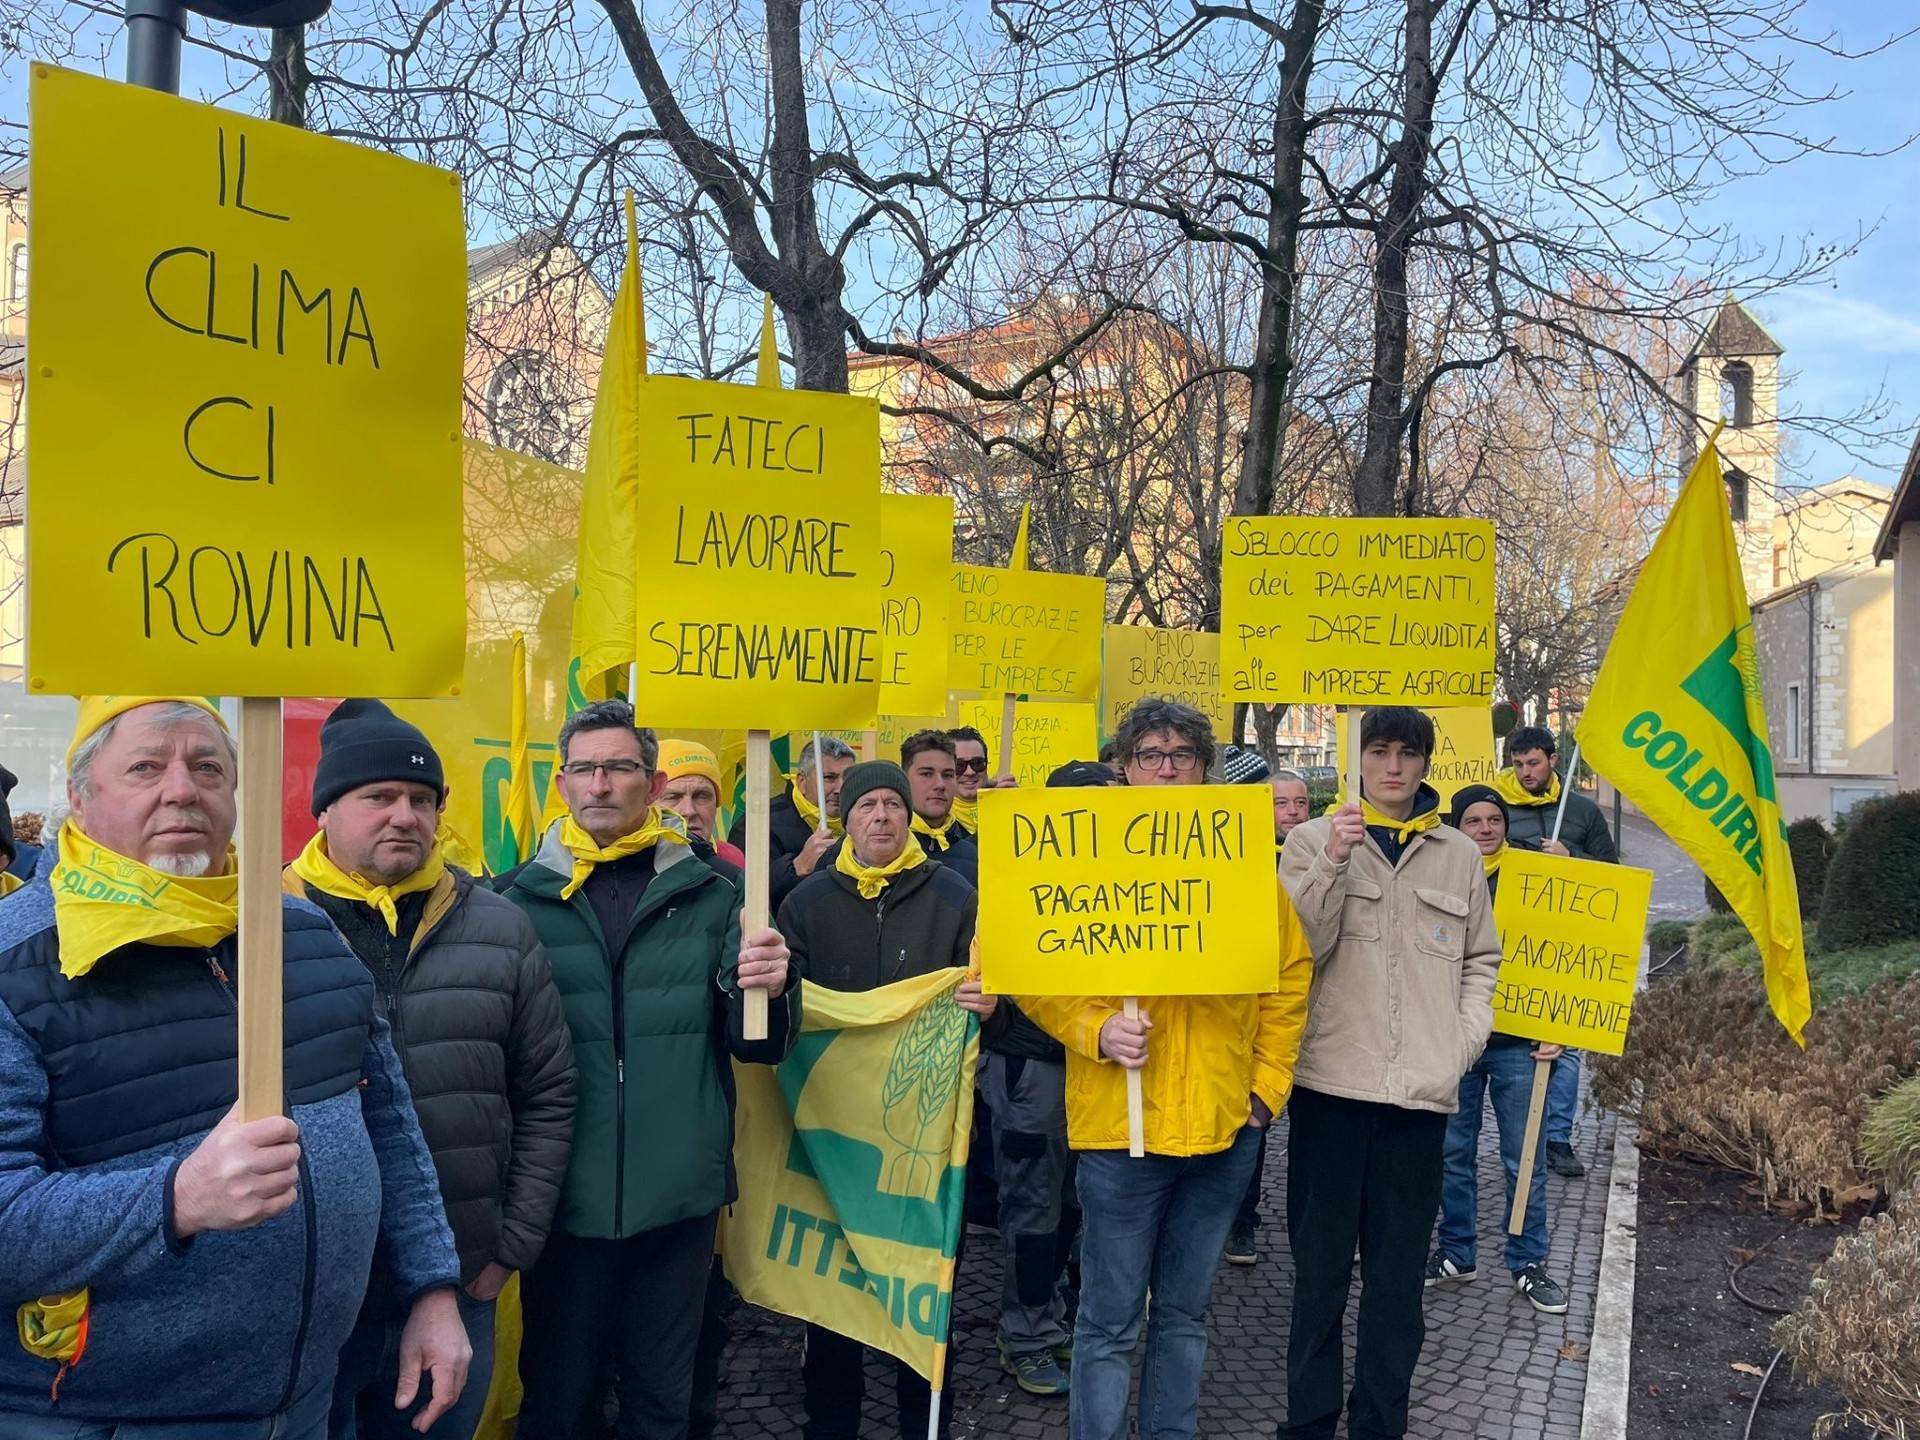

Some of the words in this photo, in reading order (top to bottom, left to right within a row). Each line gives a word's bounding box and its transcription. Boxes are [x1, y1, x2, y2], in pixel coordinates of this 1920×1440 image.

[218, 127, 290, 221] IL
[145, 246, 380, 370] CLIMA
[183, 396, 275, 484] CI
[677, 413, 824, 474] FATECI
[674, 505, 856, 578] LAVORARE
[1230, 520, 1340, 557] SBLOCCO
[1358, 532, 1486, 562] IMMEDIATO
[107, 532, 395, 652] ROVINA
[1248, 569, 1295, 597] dei
[964, 601, 1080, 633] BUROCRAZIE
[1238, 623, 1282, 651] per
[1305, 615, 1382, 646] DARE
[649, 620, 878, 684] SERENAMENTE
[954, 633, 986, 656] PER
[1001, 637, 1026, 659] LE
[1145, 630, 1194, 658] MENO
[979, 663, 1077, 694] IMPRESE
[1129, 656, 1220, 686] BUROCRAZIA
[1233, 657, 1279, 692] alle
[1303, 670, 1392, 695] IMPRESE
[1400, 670, 1493, 696] AGRICOLE
[1013, 809, 1098, 860] DATI
[1124, 809, 1244, 860] CHIARI
[1029, 879, 1211, 916] PAGAMENTI
[1517, 873, 1619, 922] FATECI
[1037, 920, 1203, 955] GARANTITI
[1500, 929, 1631, 983] LAVORARE
[1492, 979, 1631, 1034] SERENAMENTE
